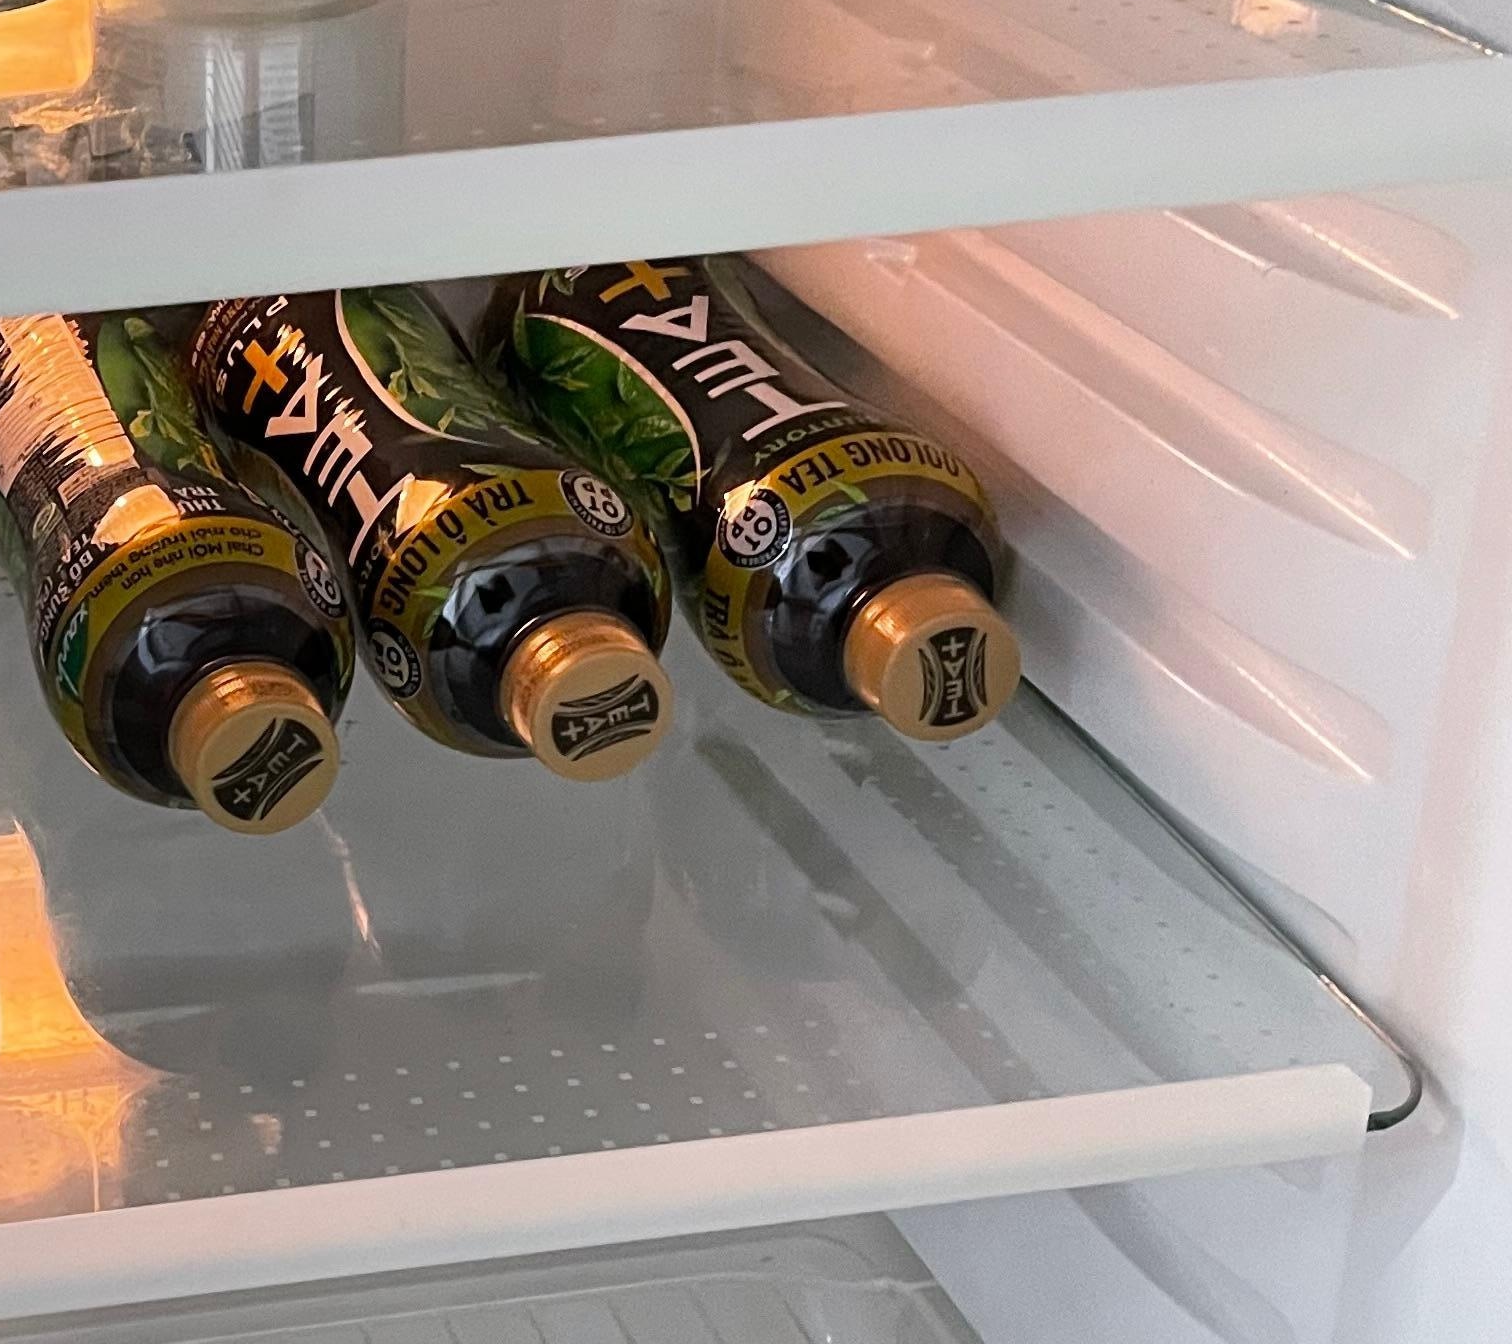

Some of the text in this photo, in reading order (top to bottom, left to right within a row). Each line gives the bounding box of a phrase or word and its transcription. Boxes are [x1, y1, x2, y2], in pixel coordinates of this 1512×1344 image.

[462, 479, 535, 526] TRÀ
[778, 452, 845, 495] TEA
[379, 536, 441, 616] LONG
[941, 636, 967, 718] TEA+
[558, 699, 652, 744] TEA+
[232, 730, 310, 808] TEA+
